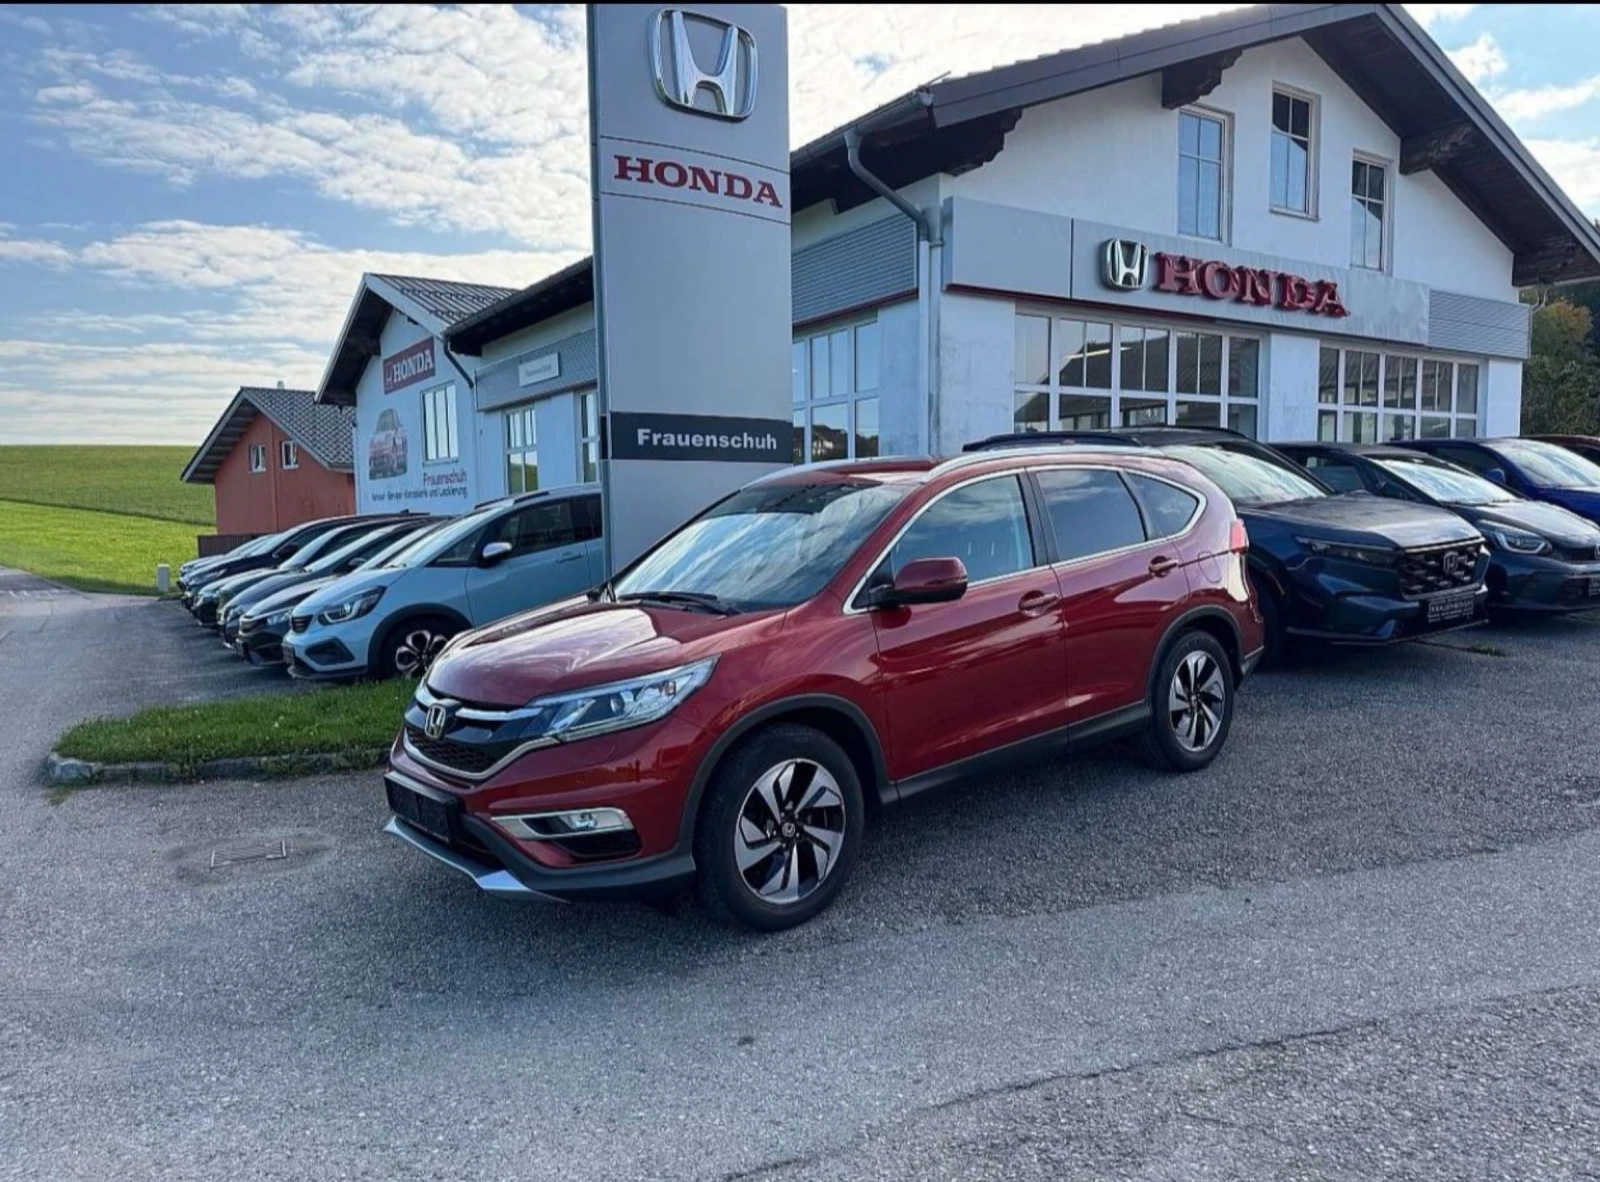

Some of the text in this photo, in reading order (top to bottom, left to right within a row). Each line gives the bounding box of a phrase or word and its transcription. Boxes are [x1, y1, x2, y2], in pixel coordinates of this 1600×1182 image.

[613, 154, 784, 208] HONDA
[1154, 251, 1350, 317] HONDA
[393, 349, 433, 384] HONDA
[637, 428, 778, 450] Frauenschuh
